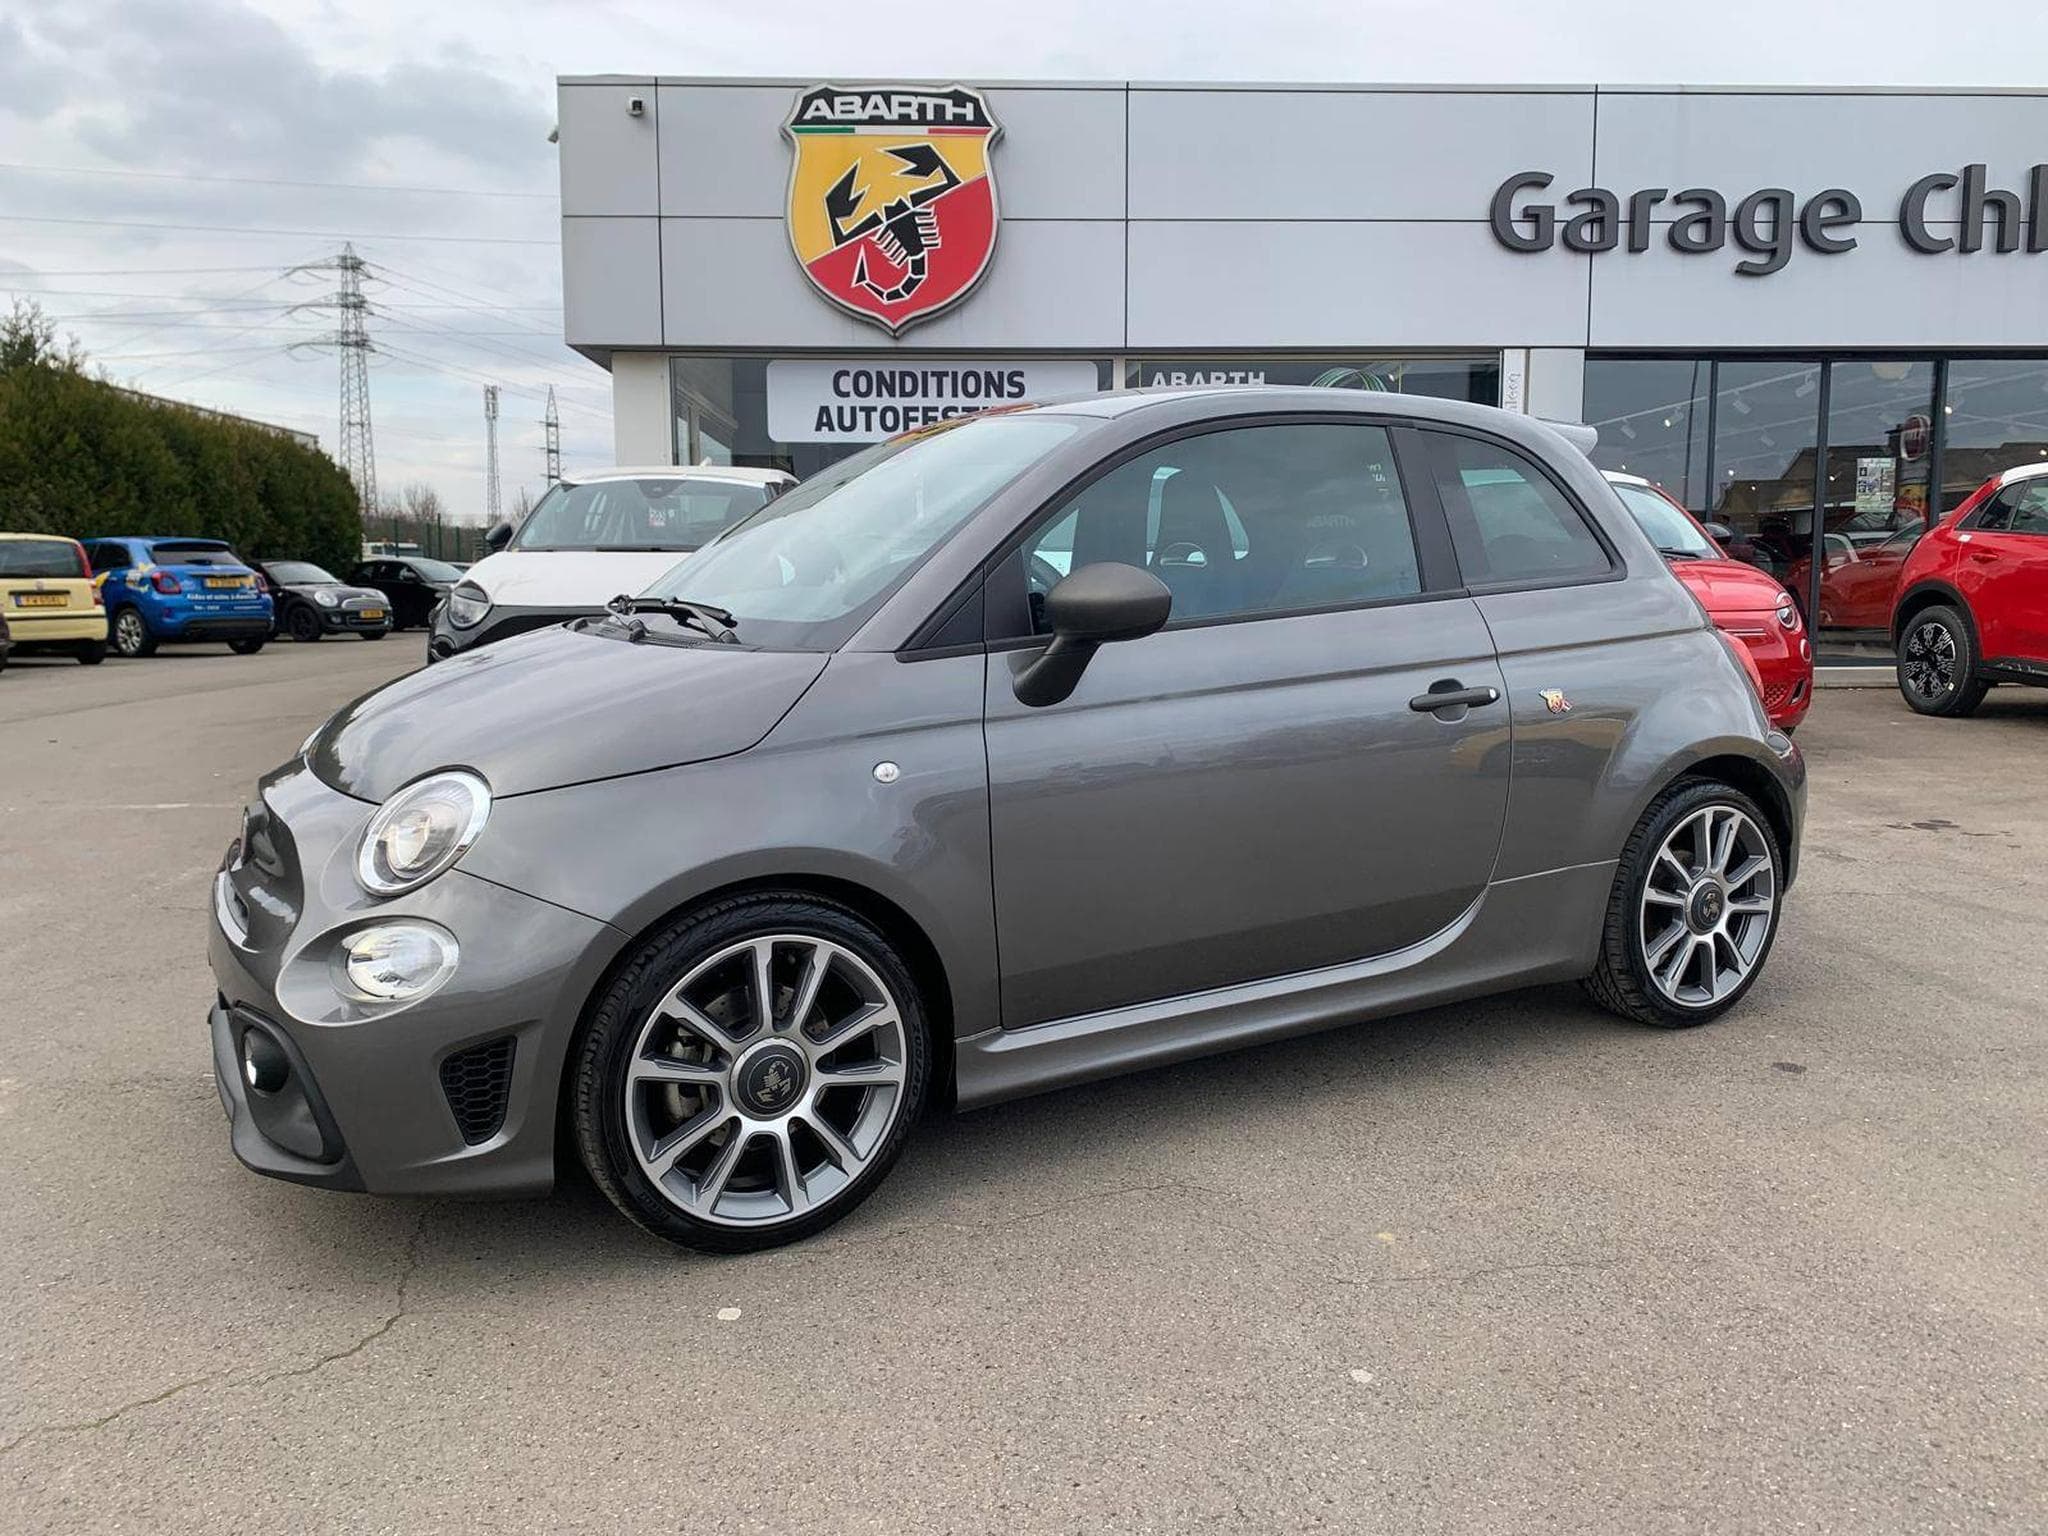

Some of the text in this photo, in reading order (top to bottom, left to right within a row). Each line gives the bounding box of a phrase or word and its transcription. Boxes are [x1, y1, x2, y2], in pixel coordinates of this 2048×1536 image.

[802, 93, 975, 122] ABARTH
[1489, 163, 2048, 276] Garage Chl
[832, 369, 1026, 399] CONDITIONS
[1151, 371, 1265, 387] ABARTH
